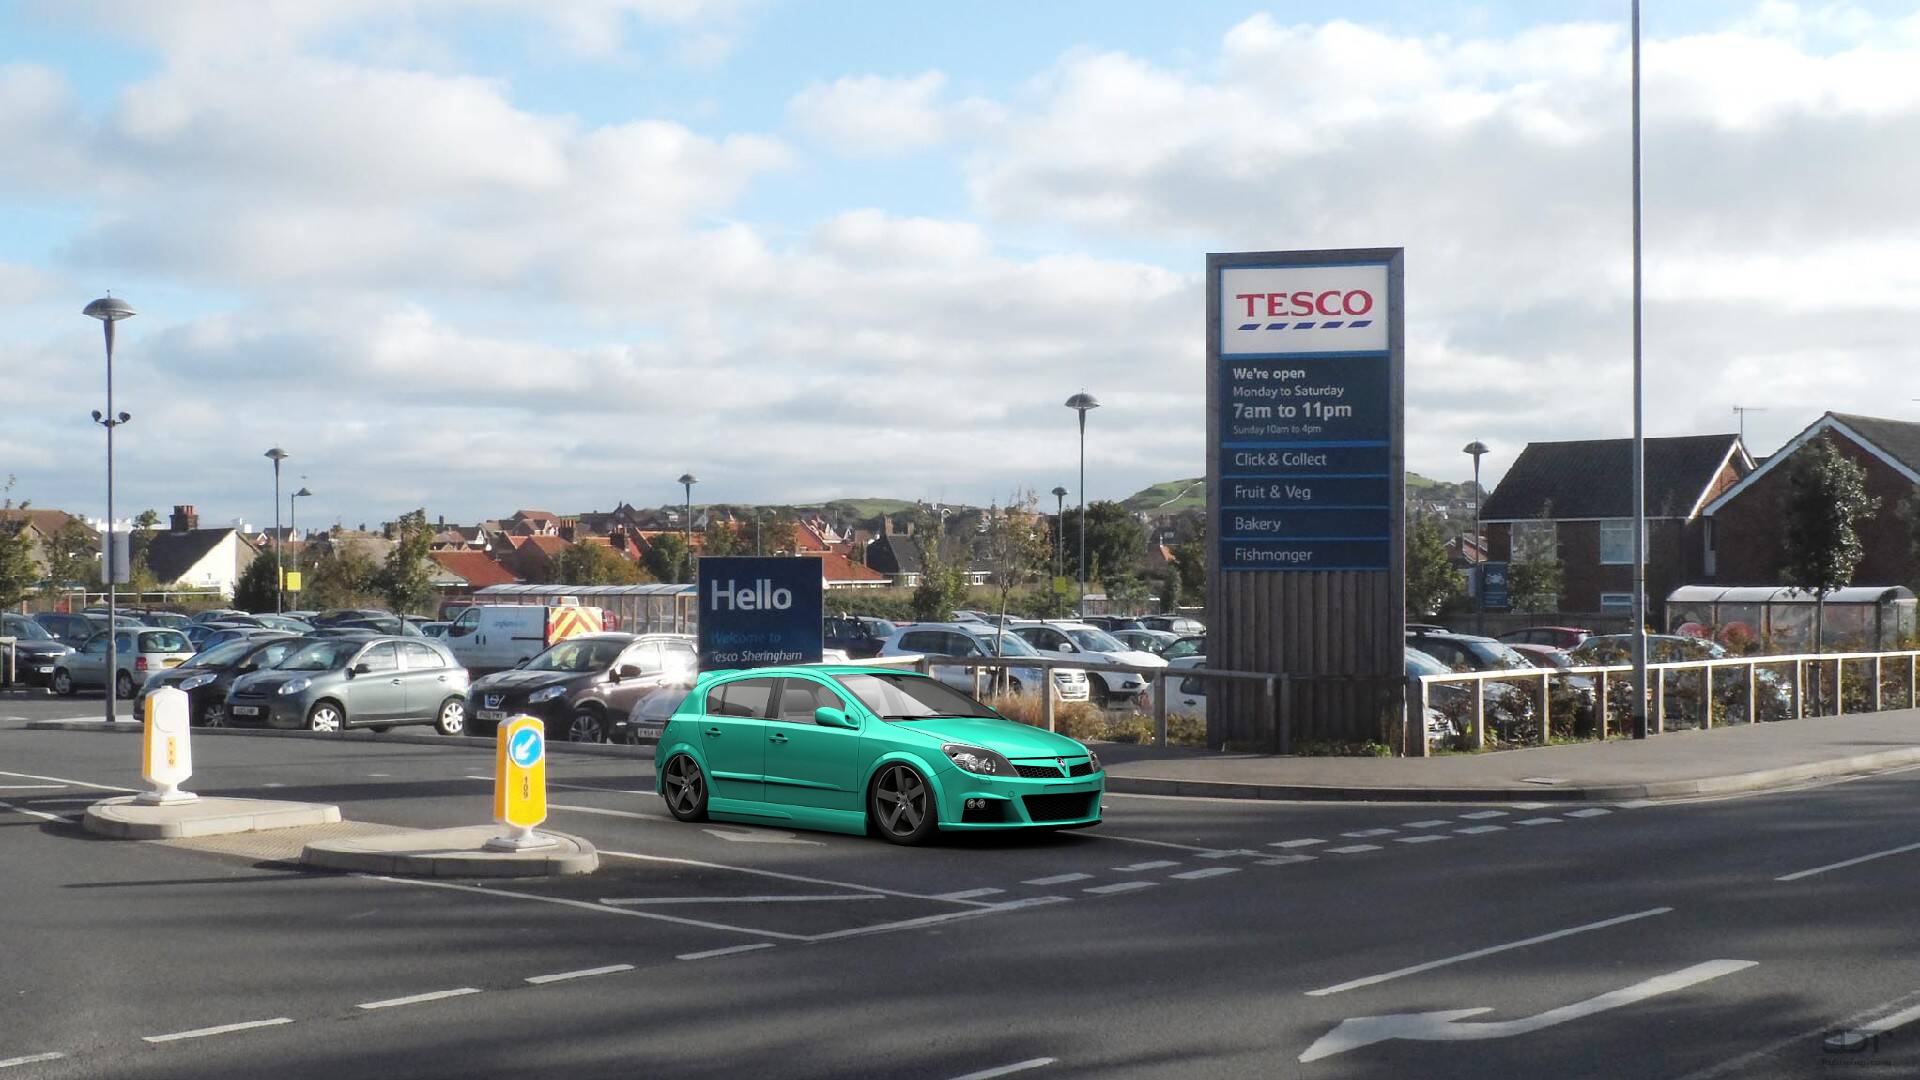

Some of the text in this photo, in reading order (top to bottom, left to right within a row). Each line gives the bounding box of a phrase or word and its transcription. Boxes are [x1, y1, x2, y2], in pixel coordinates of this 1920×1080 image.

[1235, 289, 1373, 317] TESCO
[1232, 368, 1306, 382] We're open
[1232, 385, 1345, 400] Monday to Saturday
[1232, 402, 1352, 421] 7am to 11pm
[1232, 424, 1322, 436] Sunday 10am to 4pm
[1234, 452, 1328, 466] Click & Collect
[1234, 484, 1312, 500] Fruit & Veg
[1234, 517, 1282, 532] Bakery
[1234, 547, 1313, 563] Fishmonger
[711, 579, 792, 610] Hello
[768, 631, 782, 643] to
[711, 649, 803, 664] Tesco Sheringham
